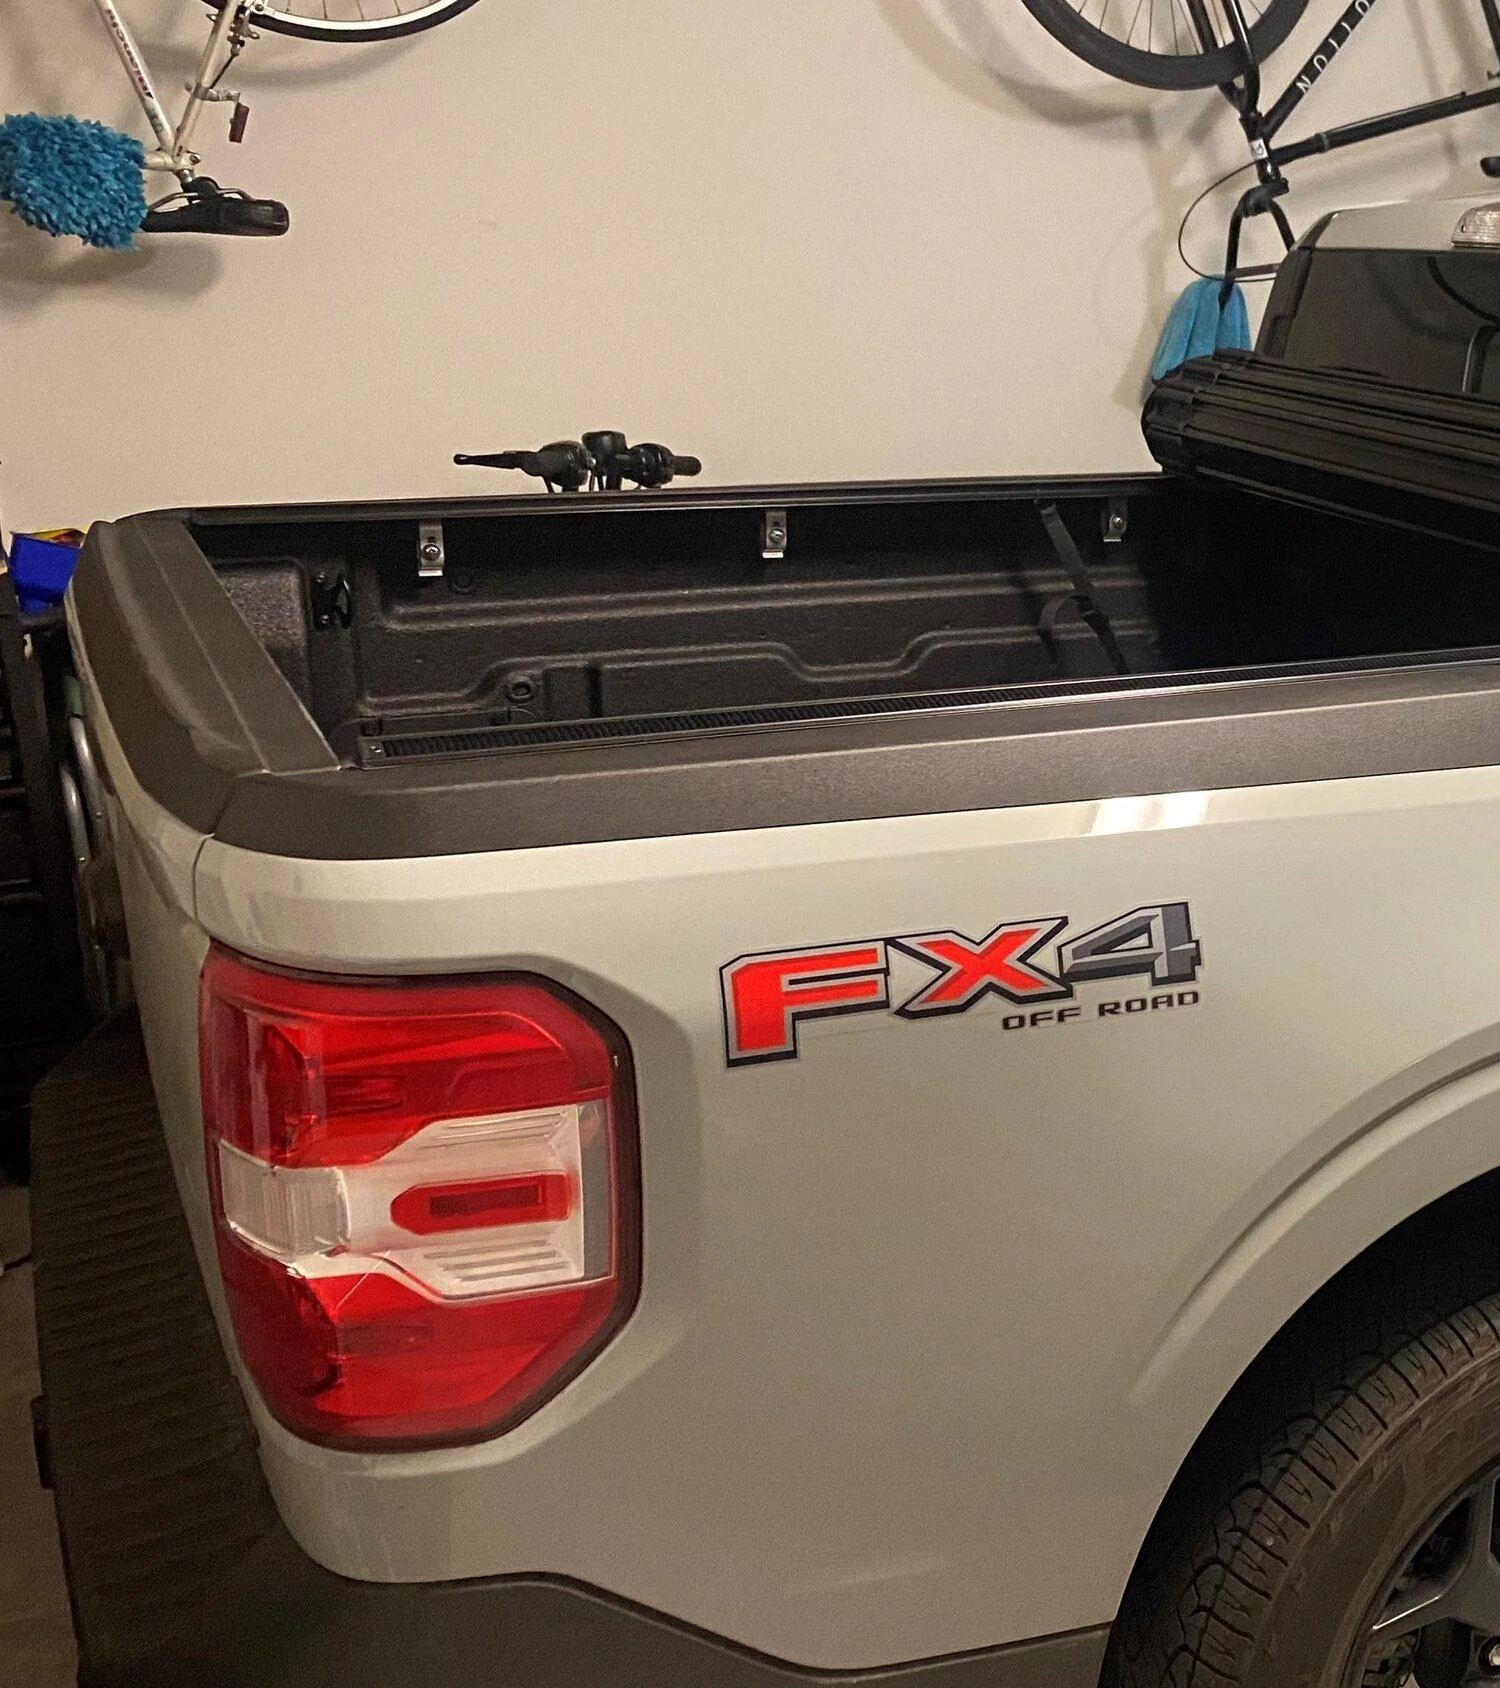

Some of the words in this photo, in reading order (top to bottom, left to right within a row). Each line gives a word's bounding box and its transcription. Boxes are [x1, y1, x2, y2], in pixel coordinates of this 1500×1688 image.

[720, 902, 1202, 1068] FX4
[1003, 1006, 1081, 1030] OFF
[1099, 990, 1199, 1017] ROAD
